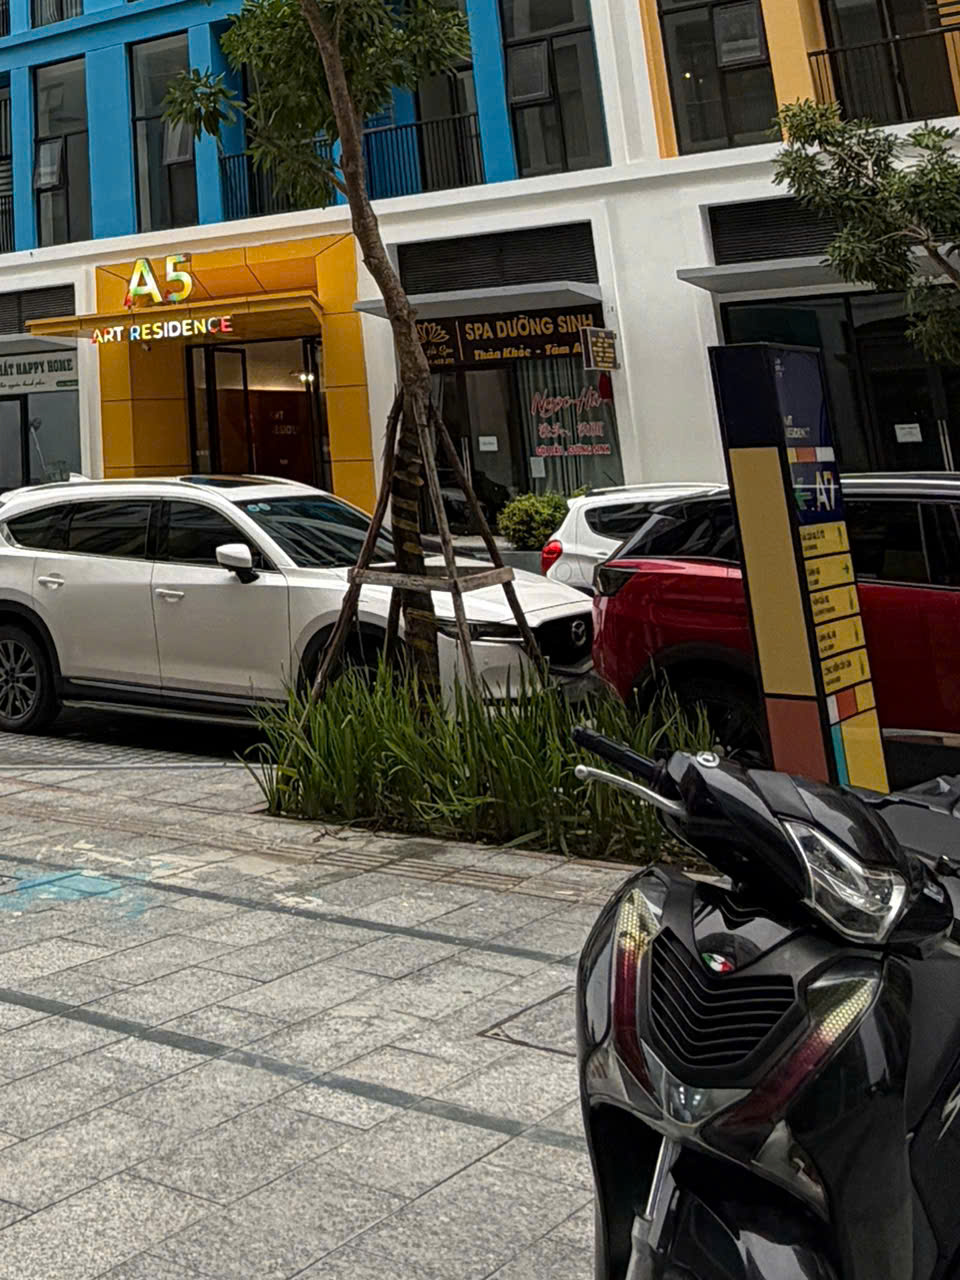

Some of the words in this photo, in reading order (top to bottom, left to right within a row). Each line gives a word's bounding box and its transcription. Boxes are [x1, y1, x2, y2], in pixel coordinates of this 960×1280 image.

[124, 253, 193, 308] A5
[90, 326, 125, 344] ART
[130, 316, 234, 341] RESIDENCE
[465, 322, 494, 341] SPA
[496, 314, 554, 338] DƯỠNG
[557, 314, 594, 333] SINH
[16, 360, 45, 376] HAPPY
[46, 358, 74, 373] HOME
